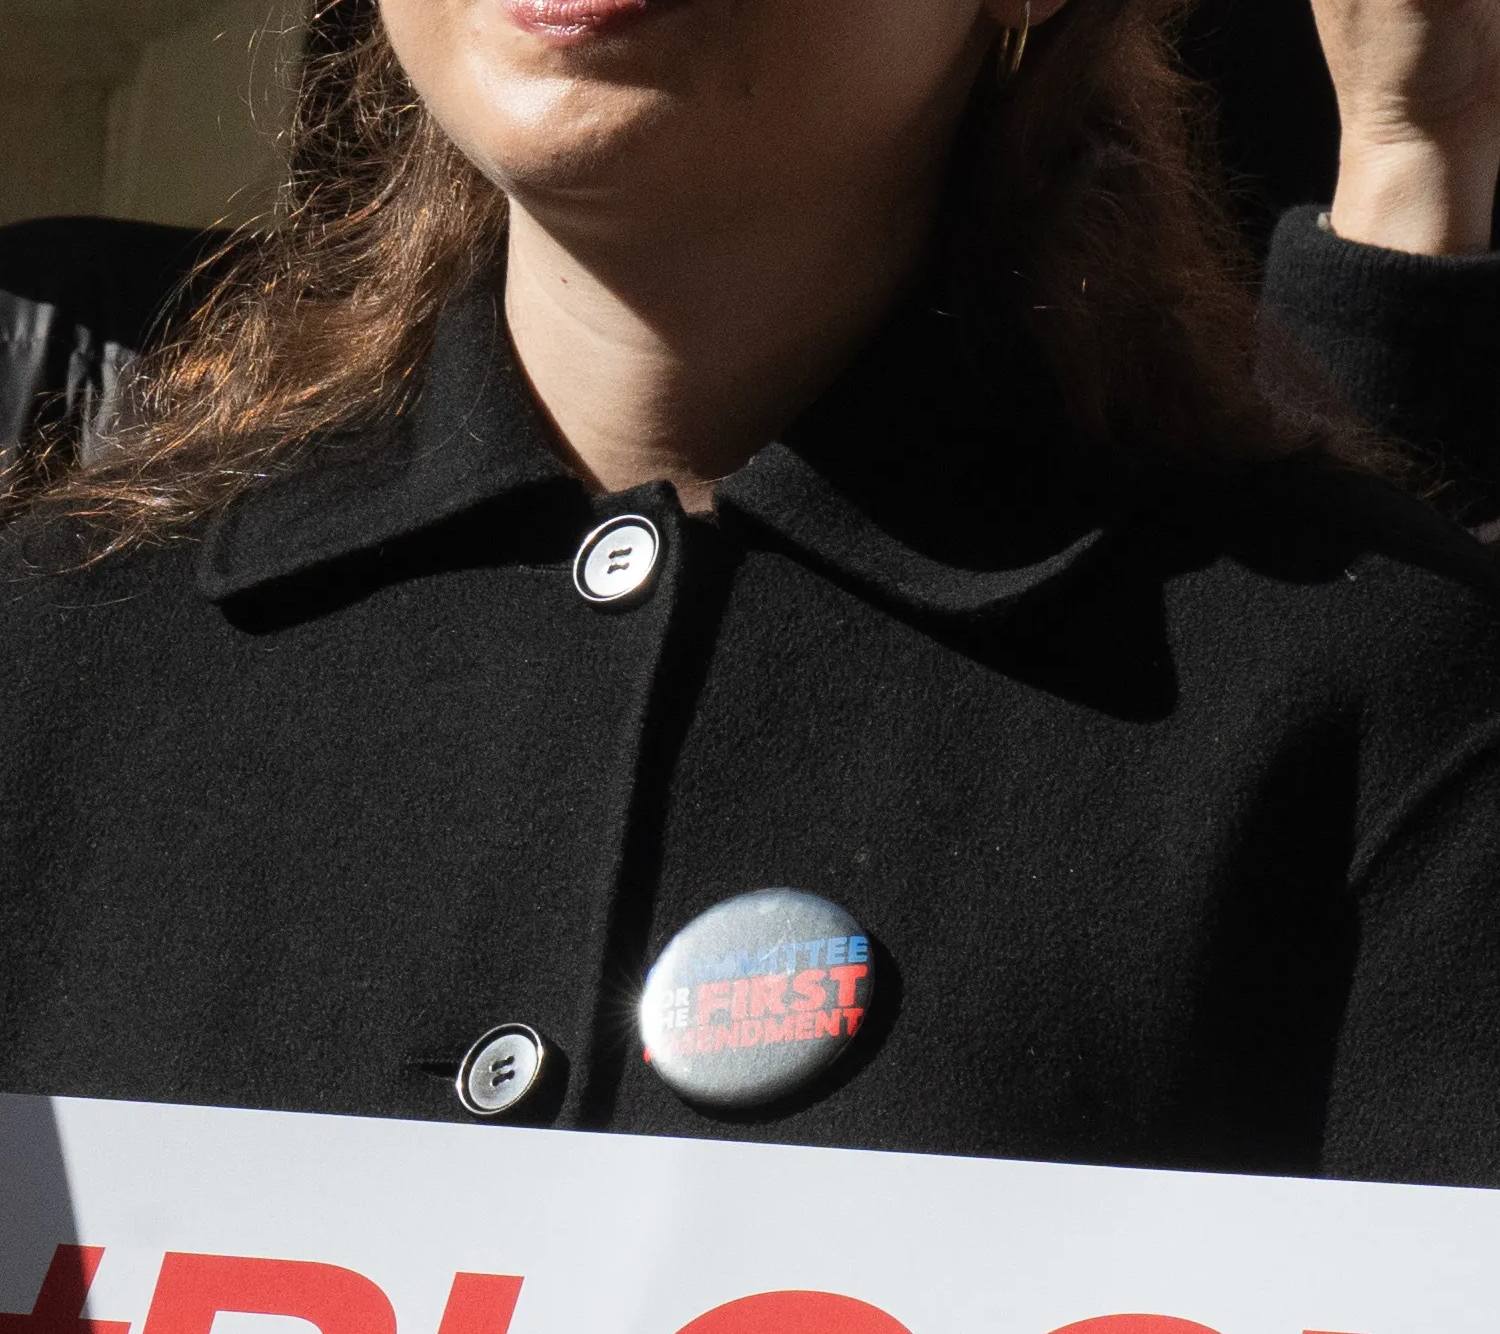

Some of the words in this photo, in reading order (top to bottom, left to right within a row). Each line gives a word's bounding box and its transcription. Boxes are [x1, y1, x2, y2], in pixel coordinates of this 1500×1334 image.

[666, 934, 869, 987] OMMITTEE
[696, 963, 869, 1027] FIRST
[654, 1007, 864, 1061] MENDMENT
